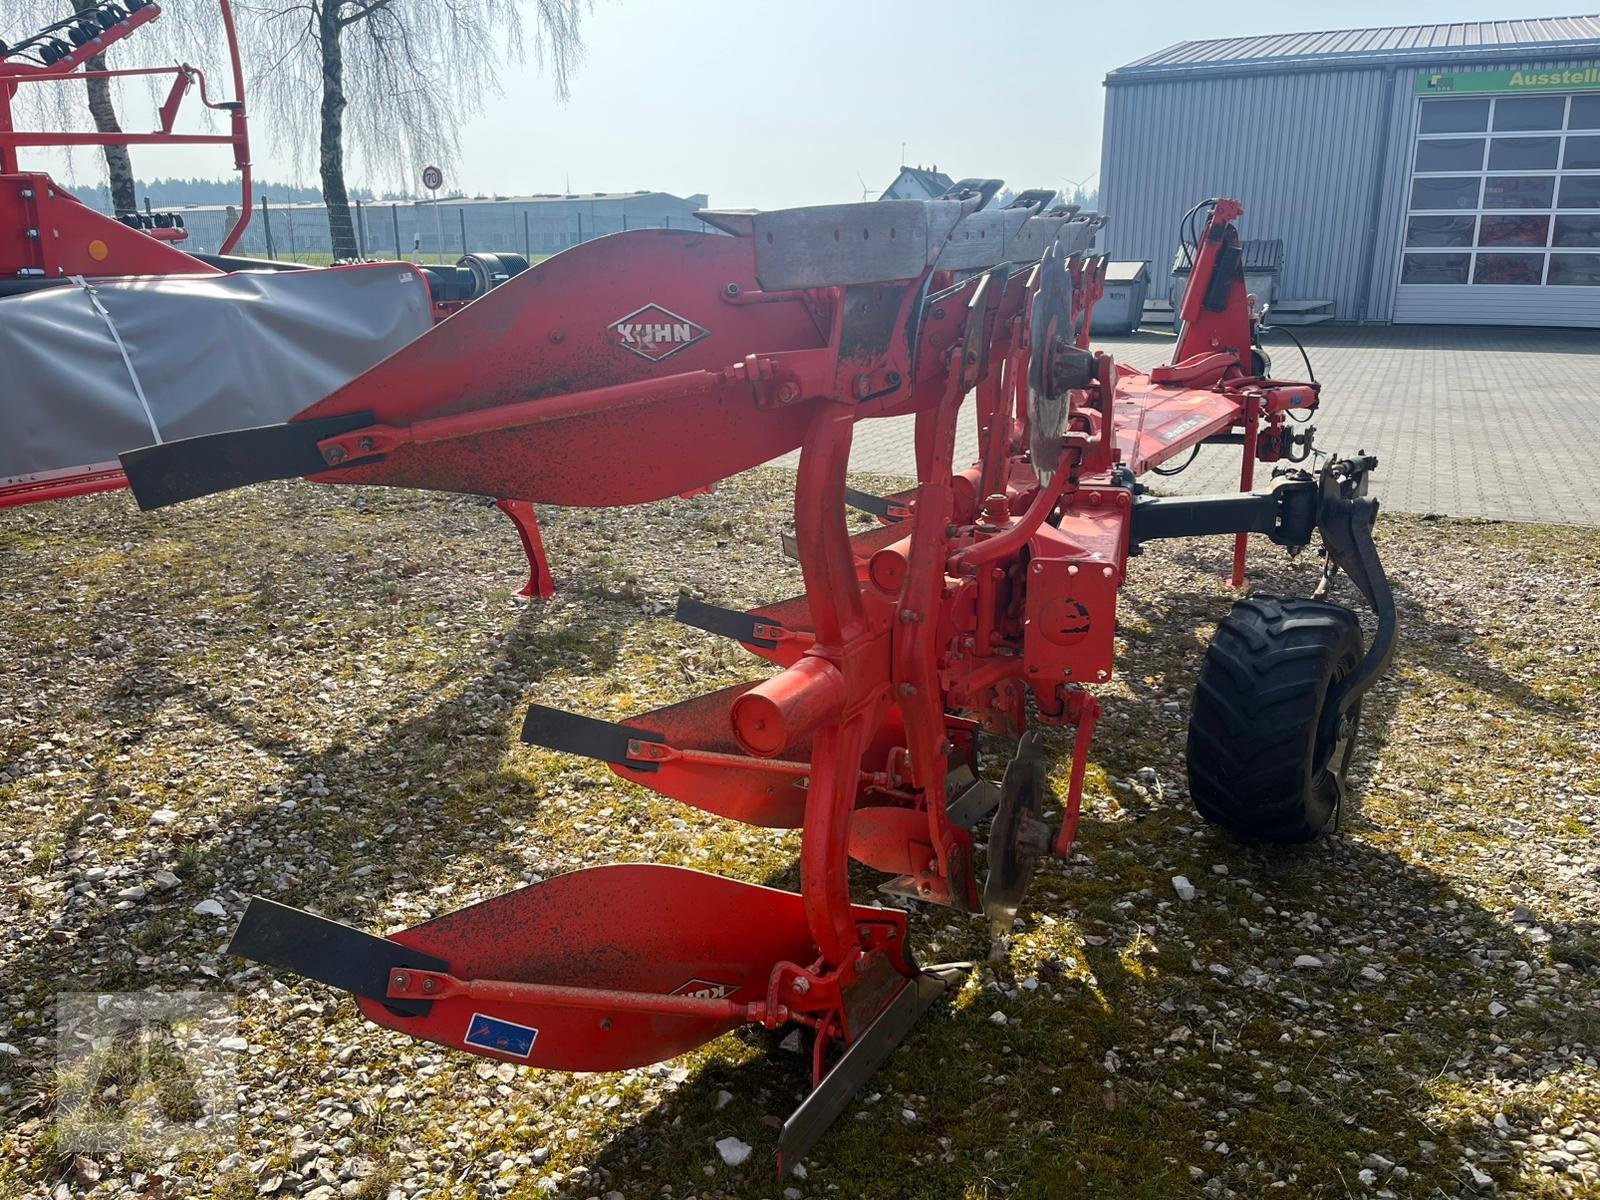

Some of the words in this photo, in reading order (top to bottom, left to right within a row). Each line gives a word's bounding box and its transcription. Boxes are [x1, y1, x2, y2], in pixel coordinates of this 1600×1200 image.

[1509, 68, 1600, 86] Ausstell
[426, 172, 437, 184] 70
[617, 323, 691, 343] KUHN
